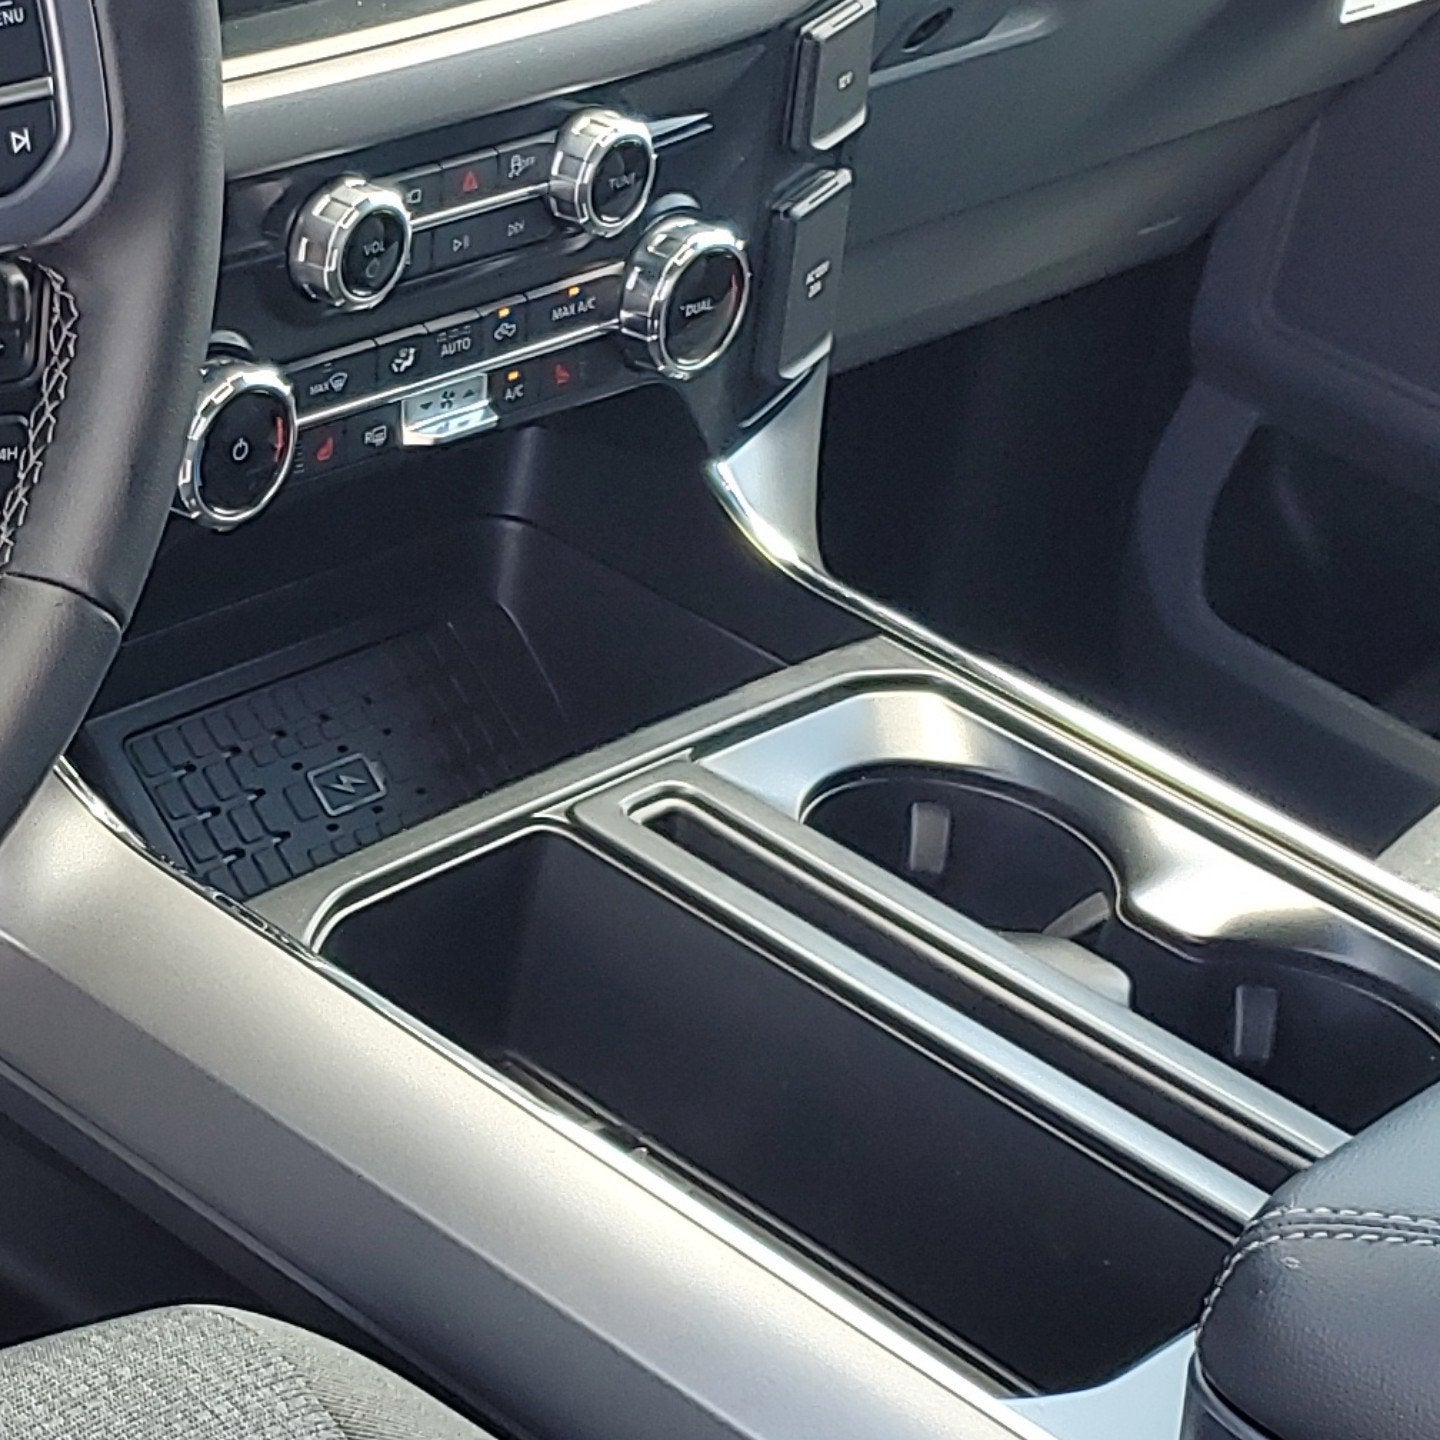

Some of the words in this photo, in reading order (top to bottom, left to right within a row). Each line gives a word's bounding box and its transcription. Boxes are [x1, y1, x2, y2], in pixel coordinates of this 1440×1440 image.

[363, 241, 386, 256] VOL
[551, 302, 577, 322] MAX
[577, 296, 597, 314] A/C
[440, 336, 472, 358] AUTO
[504, 383, 525, 401] A/C
